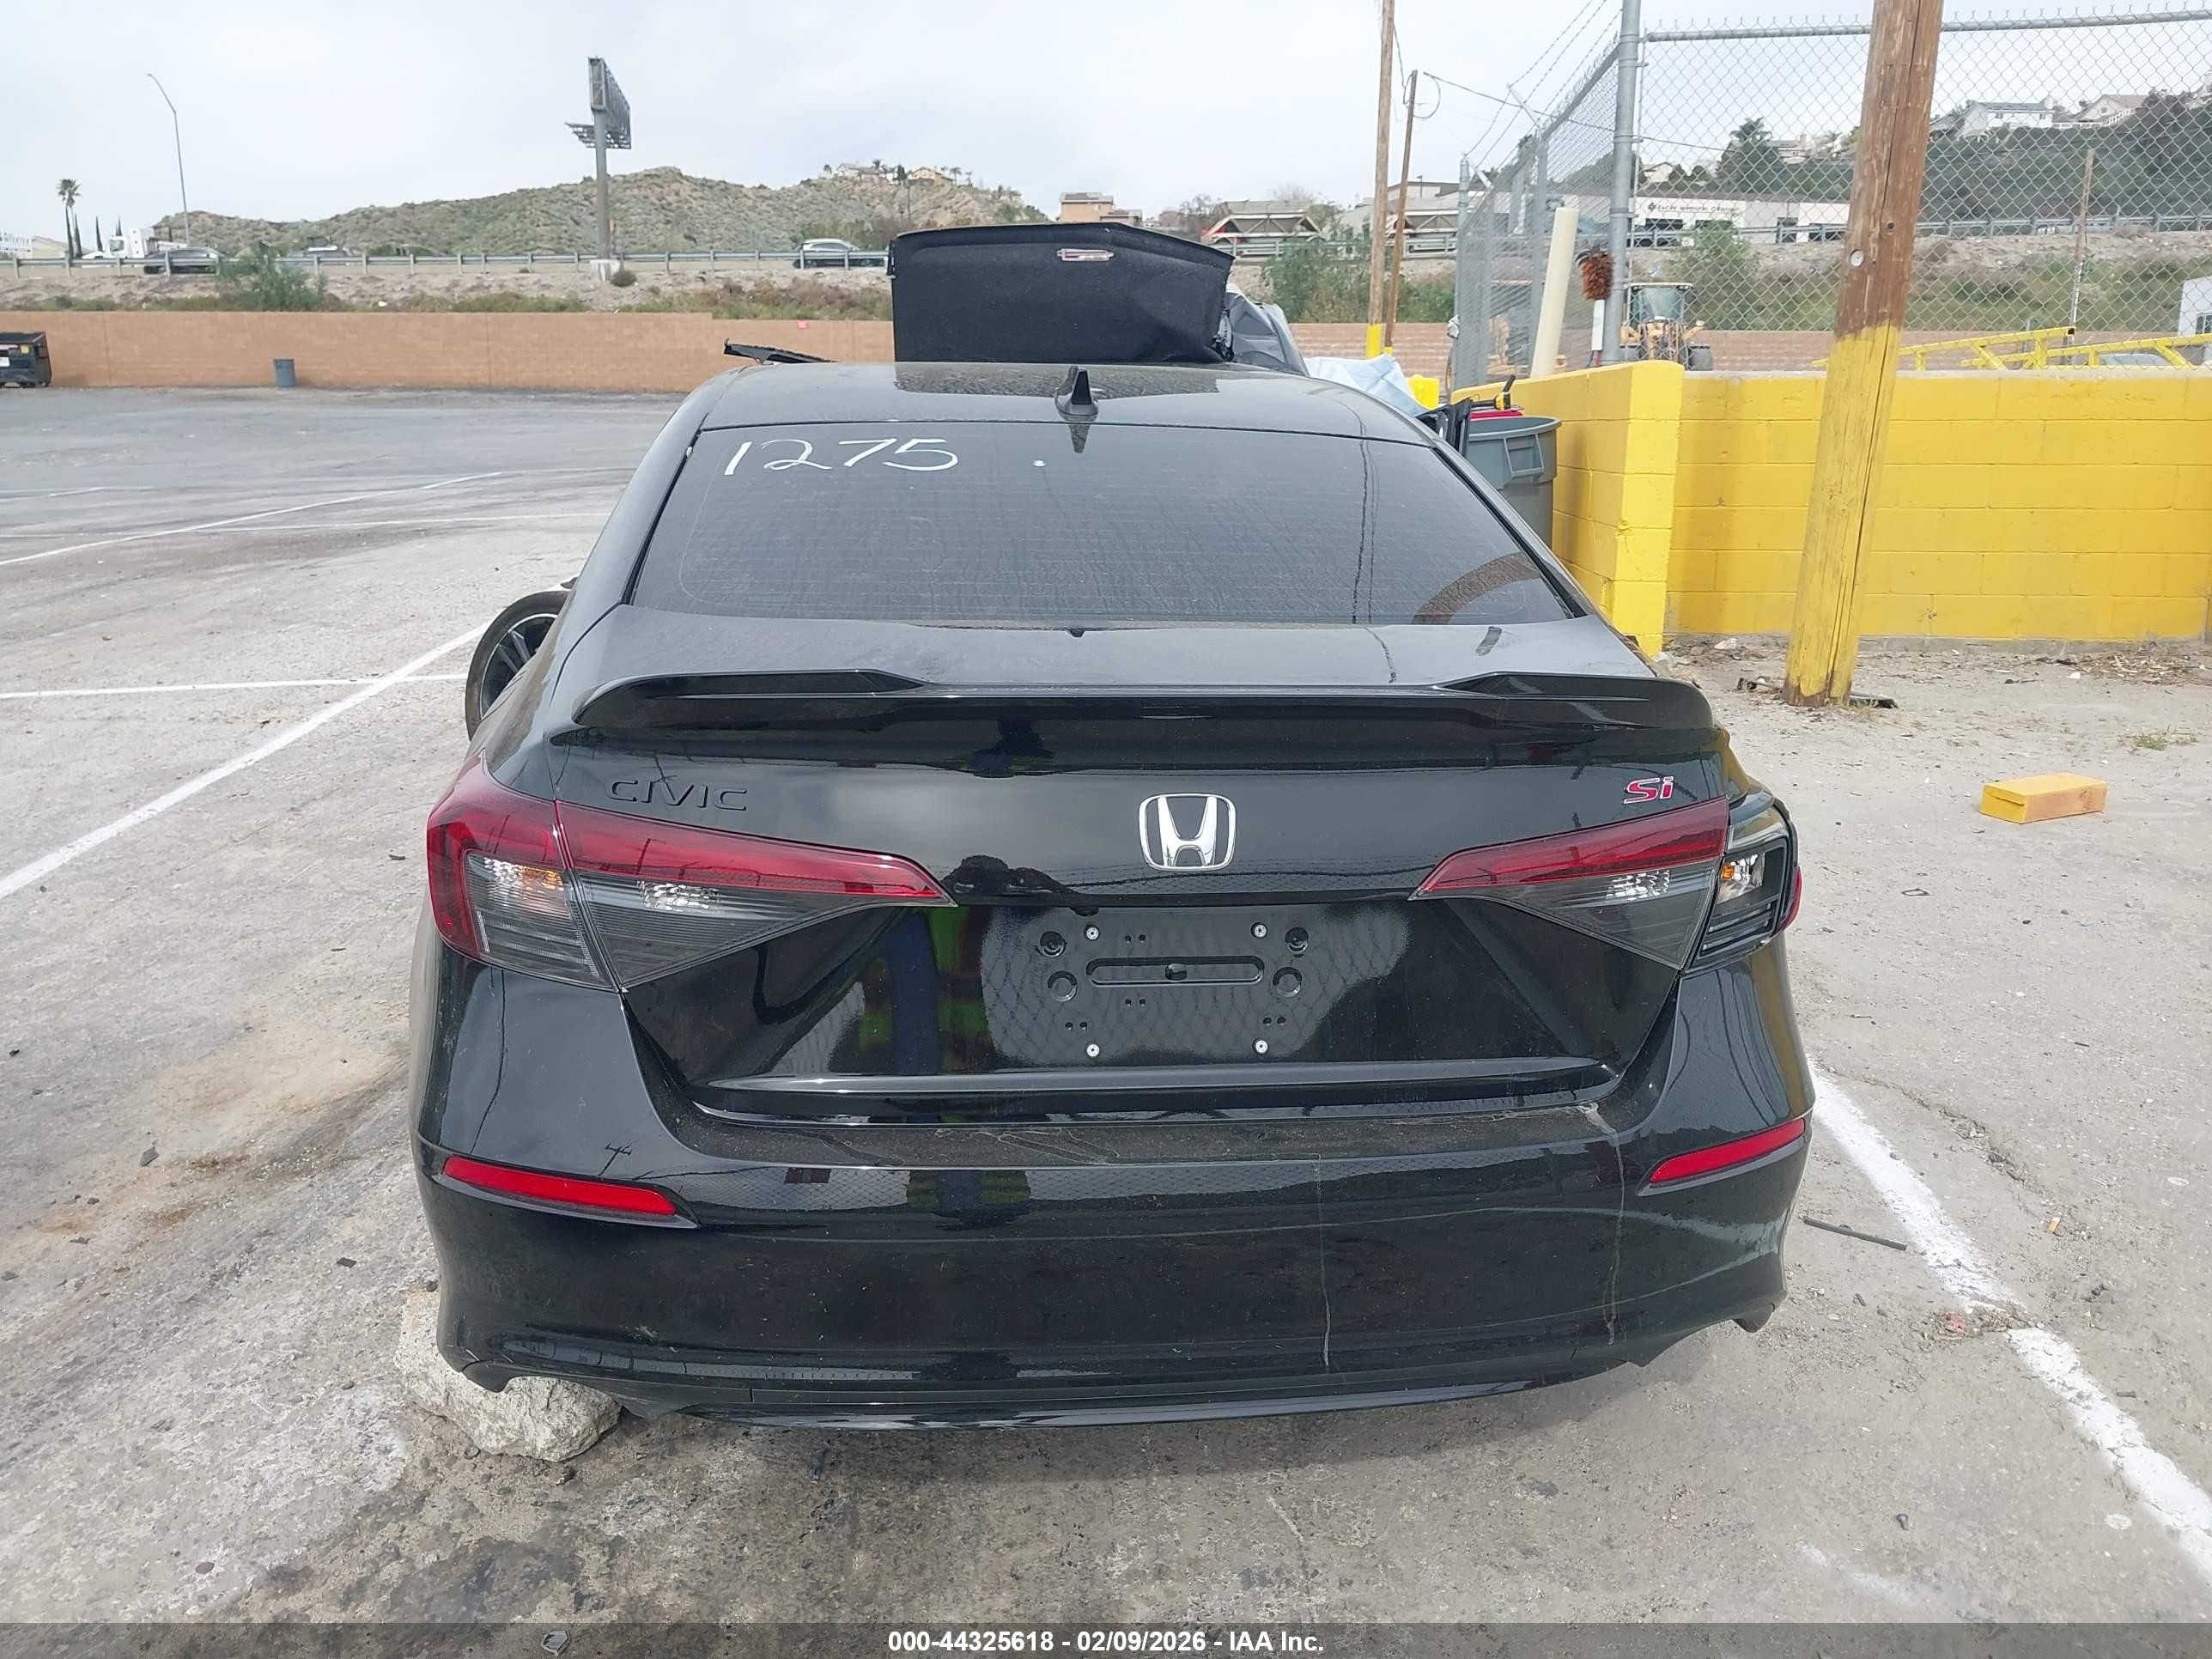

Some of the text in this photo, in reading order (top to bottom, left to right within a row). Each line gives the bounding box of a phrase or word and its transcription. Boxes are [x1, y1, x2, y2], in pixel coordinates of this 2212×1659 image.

[723, 438, 959, 476] 1275
[606, 779, 748, 811] CIVIC
[1623, 775, 1674, 805] Si
